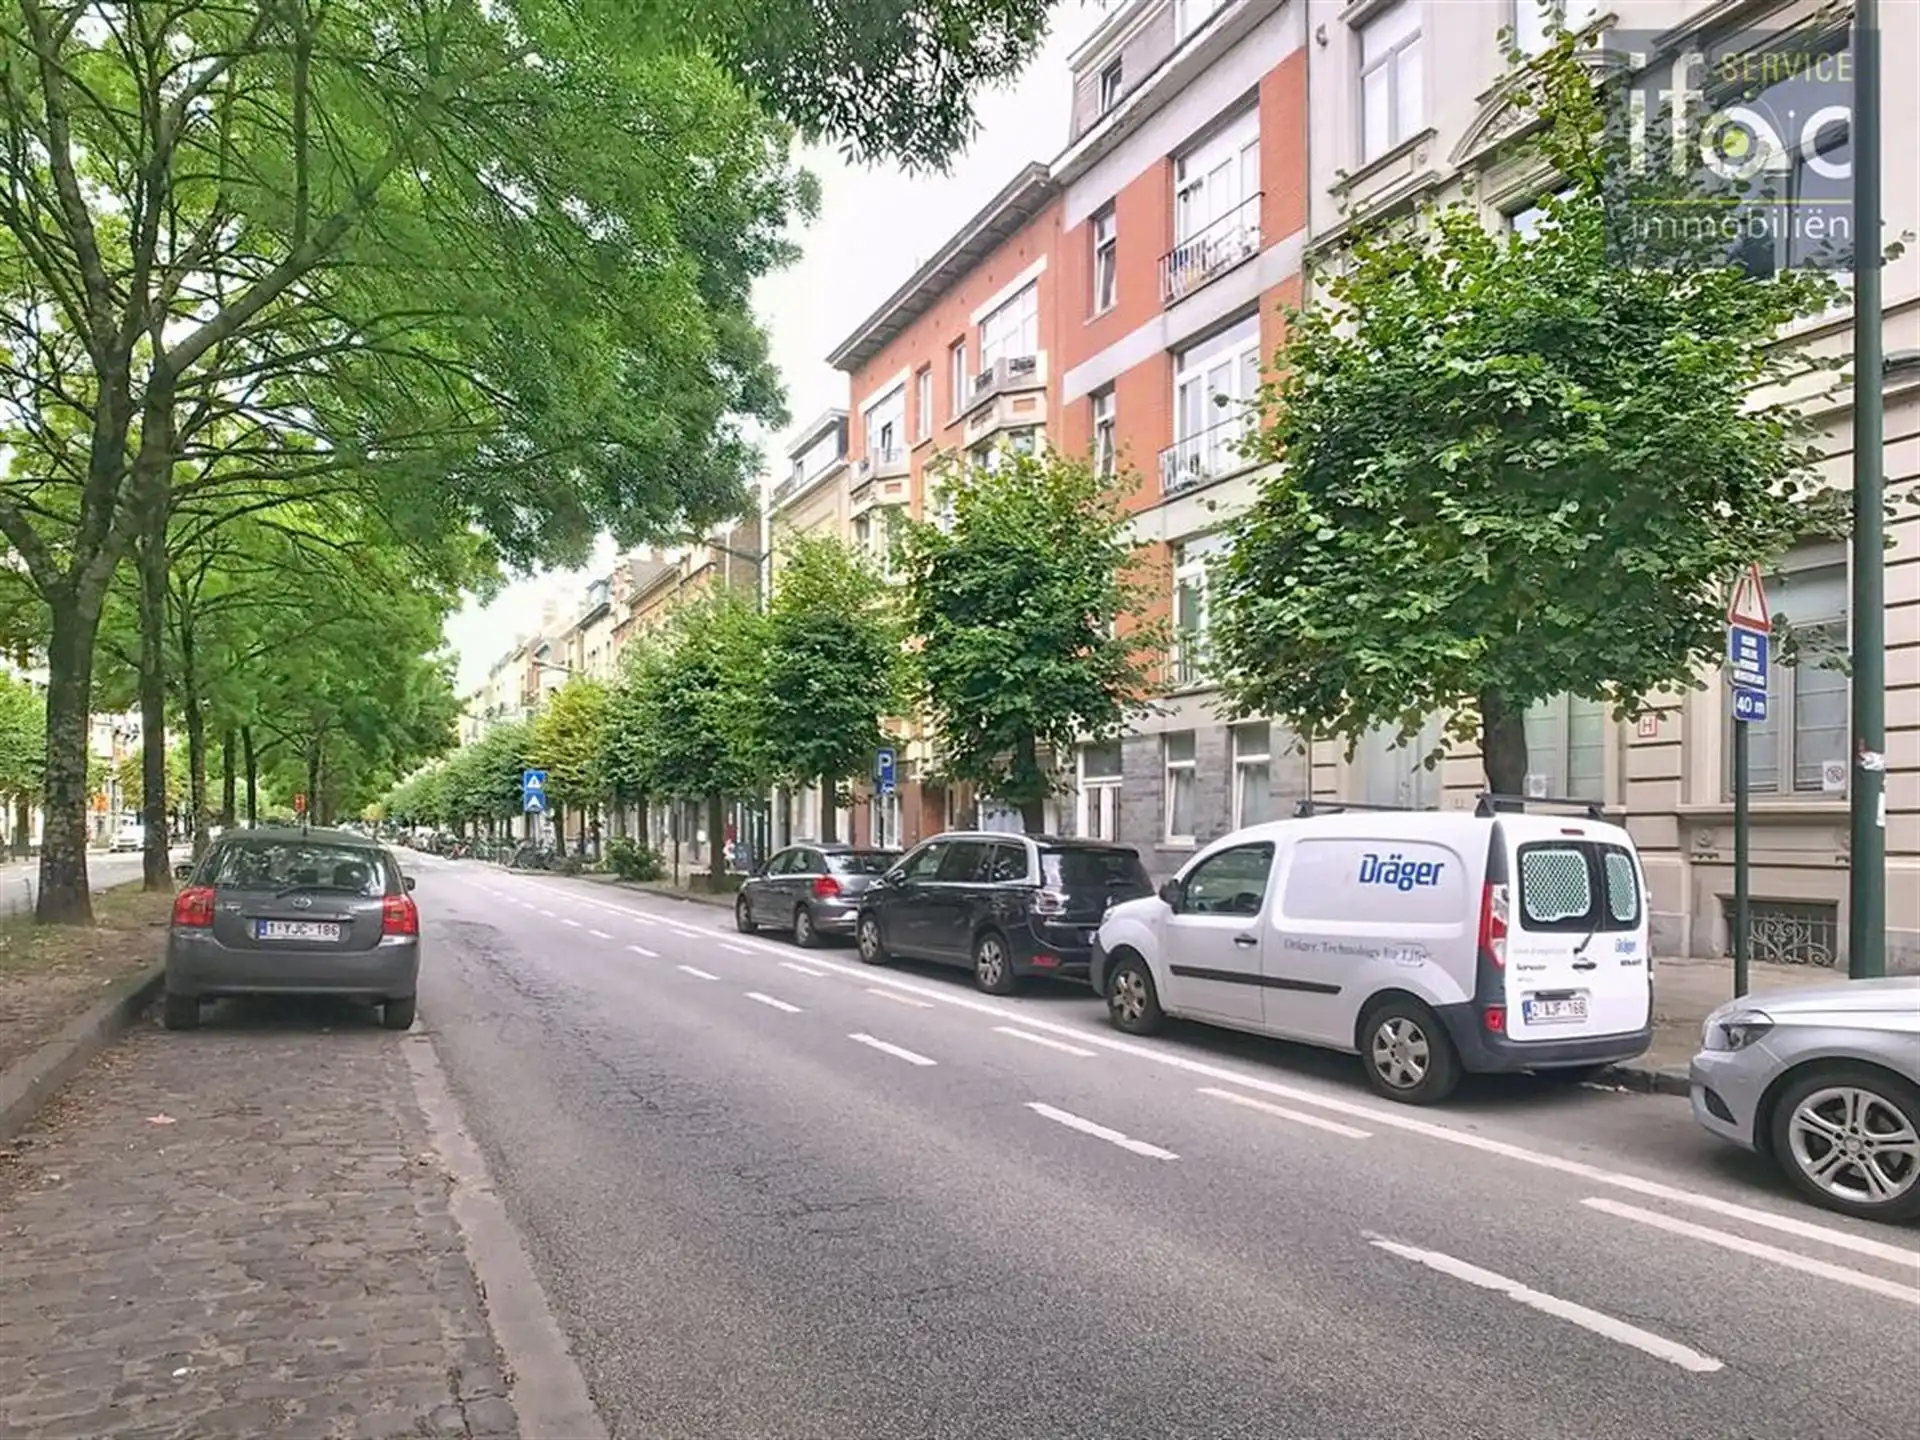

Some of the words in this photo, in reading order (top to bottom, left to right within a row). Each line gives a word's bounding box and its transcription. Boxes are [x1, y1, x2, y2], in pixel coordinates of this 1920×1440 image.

[1736, 695, 1753, 714] 40
[878, 753, 893, 777] P
[1358, 853, 1445, 892] Dräger
